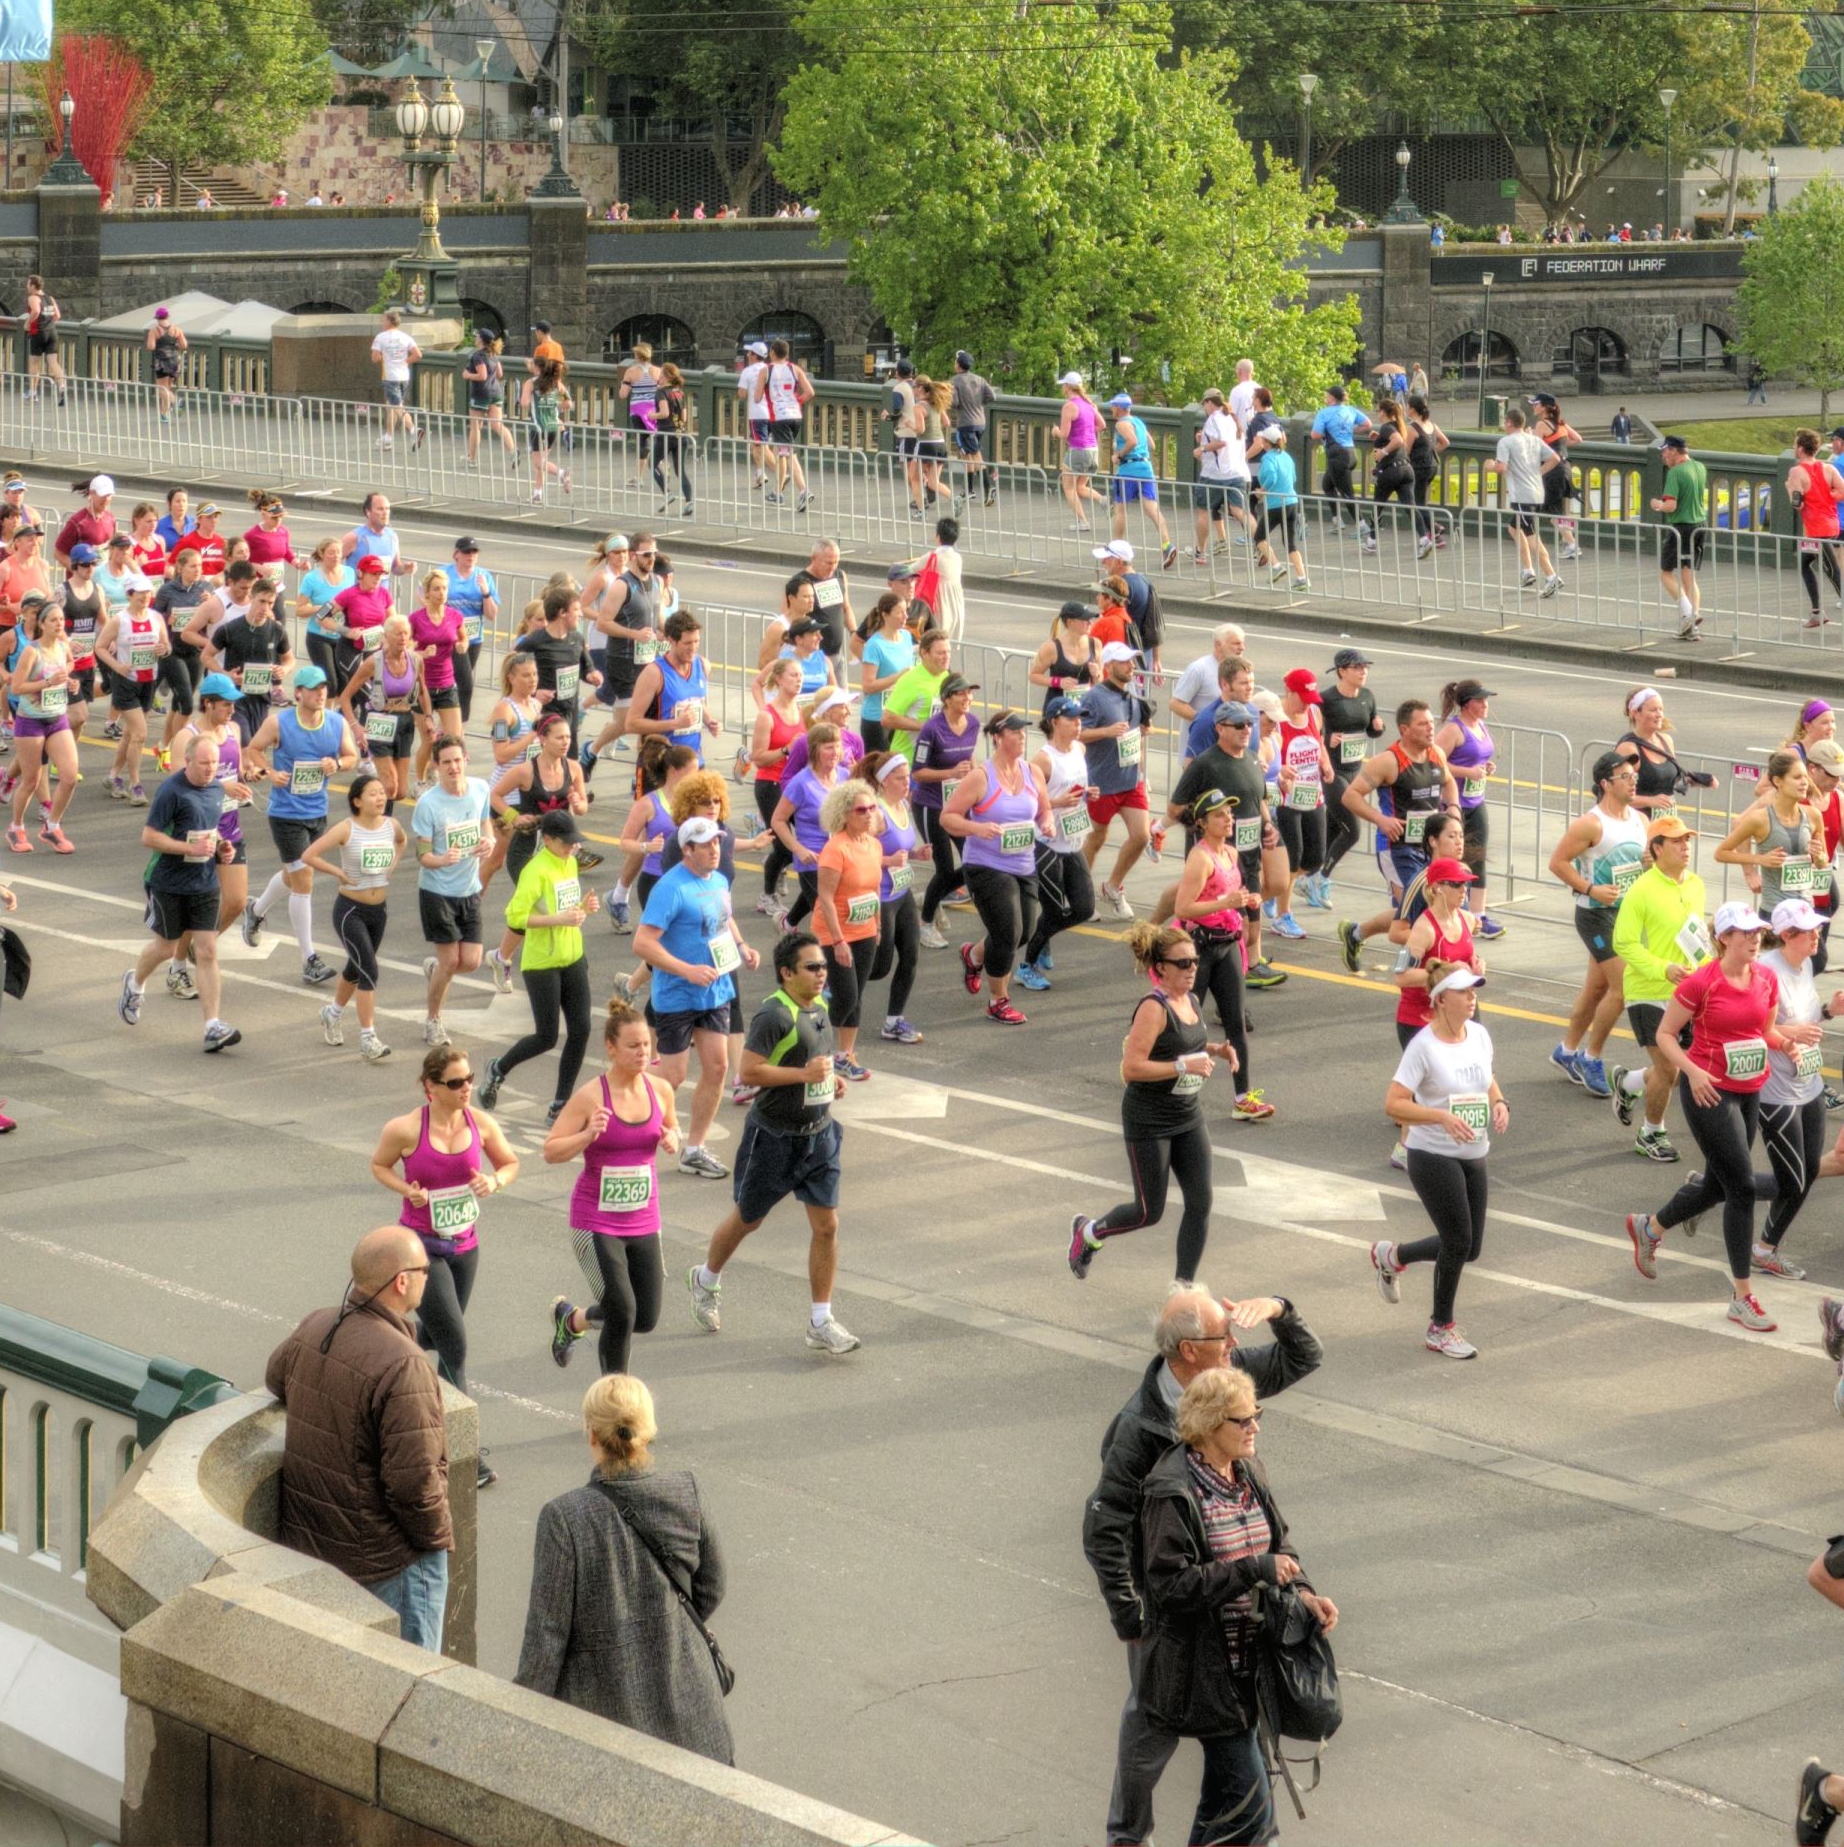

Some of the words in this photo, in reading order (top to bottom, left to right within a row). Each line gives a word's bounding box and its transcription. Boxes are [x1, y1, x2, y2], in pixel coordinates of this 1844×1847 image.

[1547, 259, 1623, 273] FEDERATION
[1628, 258, 1666, 272] WHARF
[1290, 748, 1319, 759] FLIGHT
[1006, 831, 1034, 846] 21273
[364, 851, 392, 867] 23979
[1732, 1054, 1763, 1073] 20017
[605, 1182, 648, 1203] 22369
[435, 1201, 476, 1227] 20642
